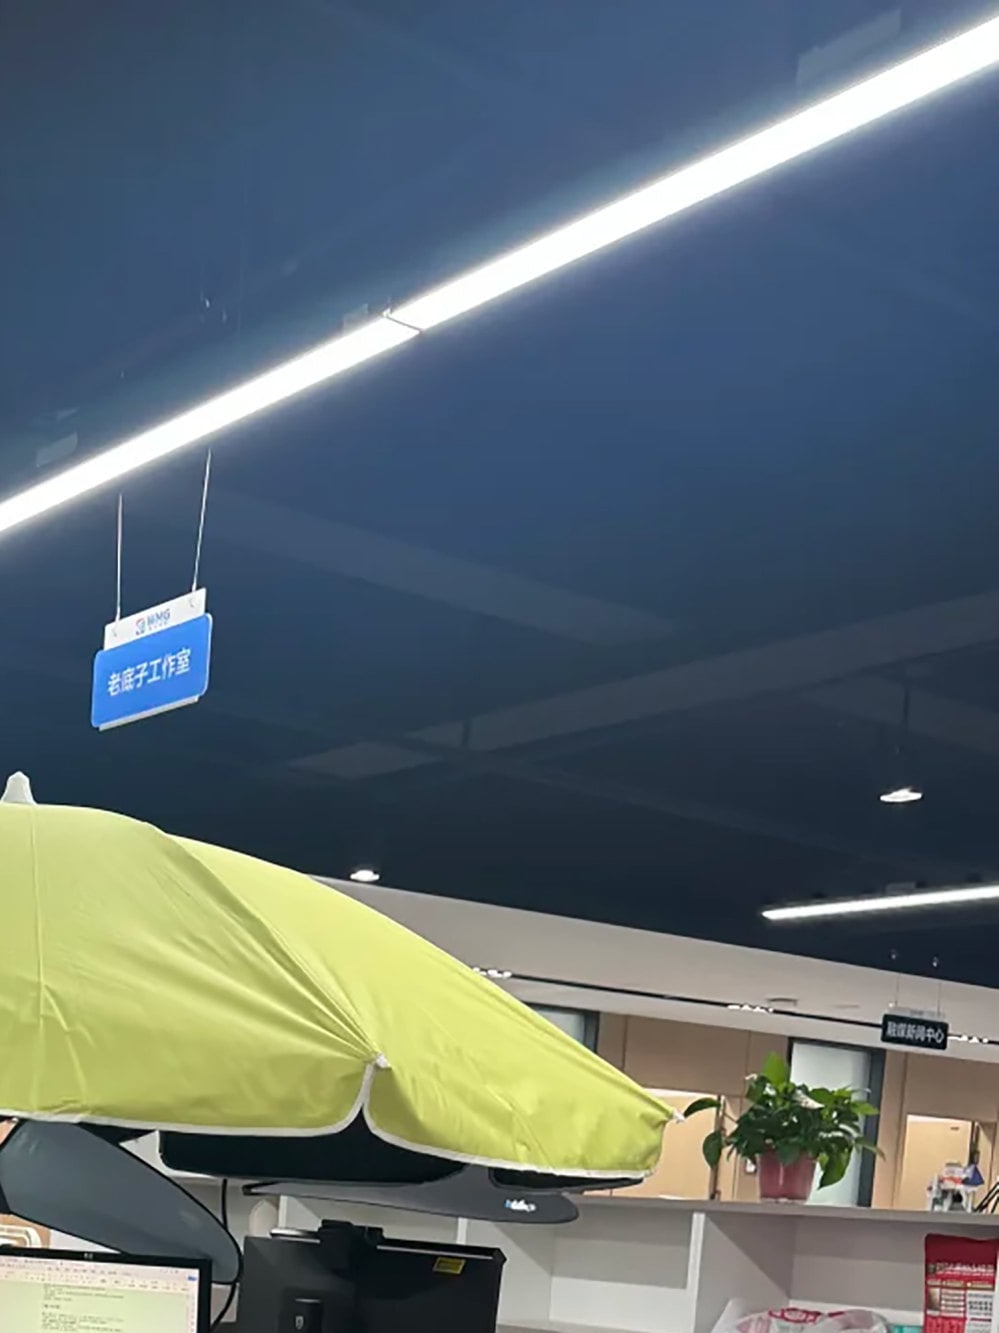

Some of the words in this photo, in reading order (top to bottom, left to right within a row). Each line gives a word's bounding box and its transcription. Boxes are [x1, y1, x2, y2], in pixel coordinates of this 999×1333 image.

[107, 648, 191, 696] 老底子工作室
